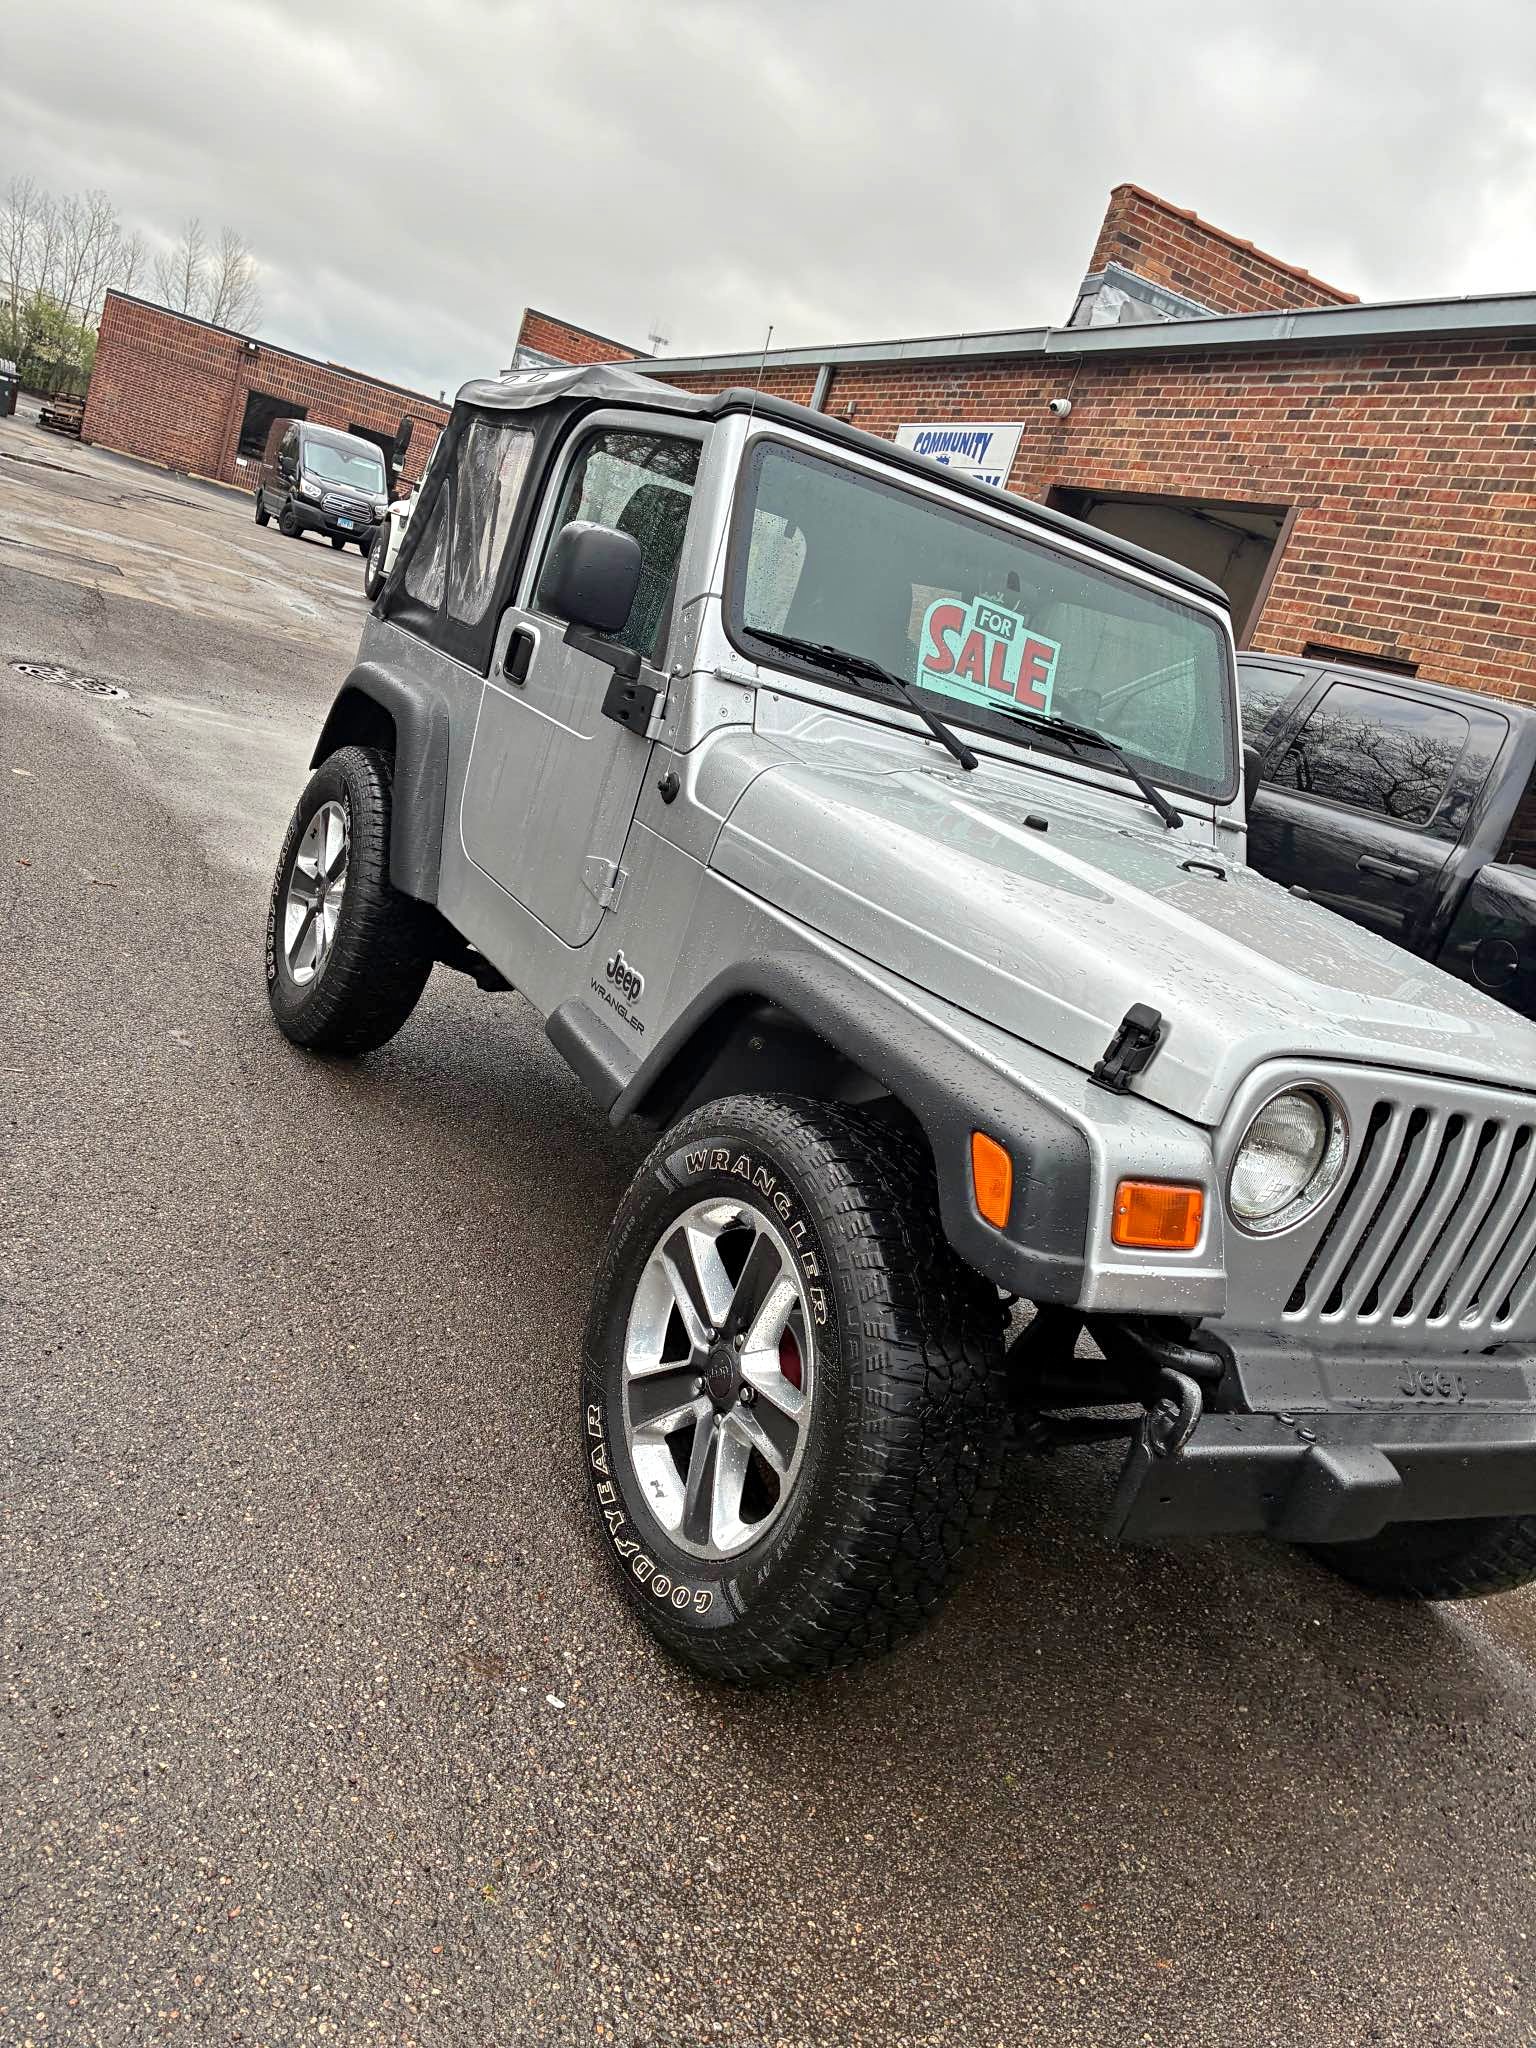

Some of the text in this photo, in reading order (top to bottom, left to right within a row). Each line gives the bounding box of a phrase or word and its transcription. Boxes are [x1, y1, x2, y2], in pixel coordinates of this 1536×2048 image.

[913, 432, 993, 464] COMMUNITY
[979, 609, 1011, 636] FOR
[923, 604, 1056, 711] SALE
[590, 977, 645, 1036] WRANGLER
[607, 953, 641, 1001] Jeep
[685, 1149, 827, 1325] WRANGLER
[587, 1404, 713, 1613] GOODYEAR
